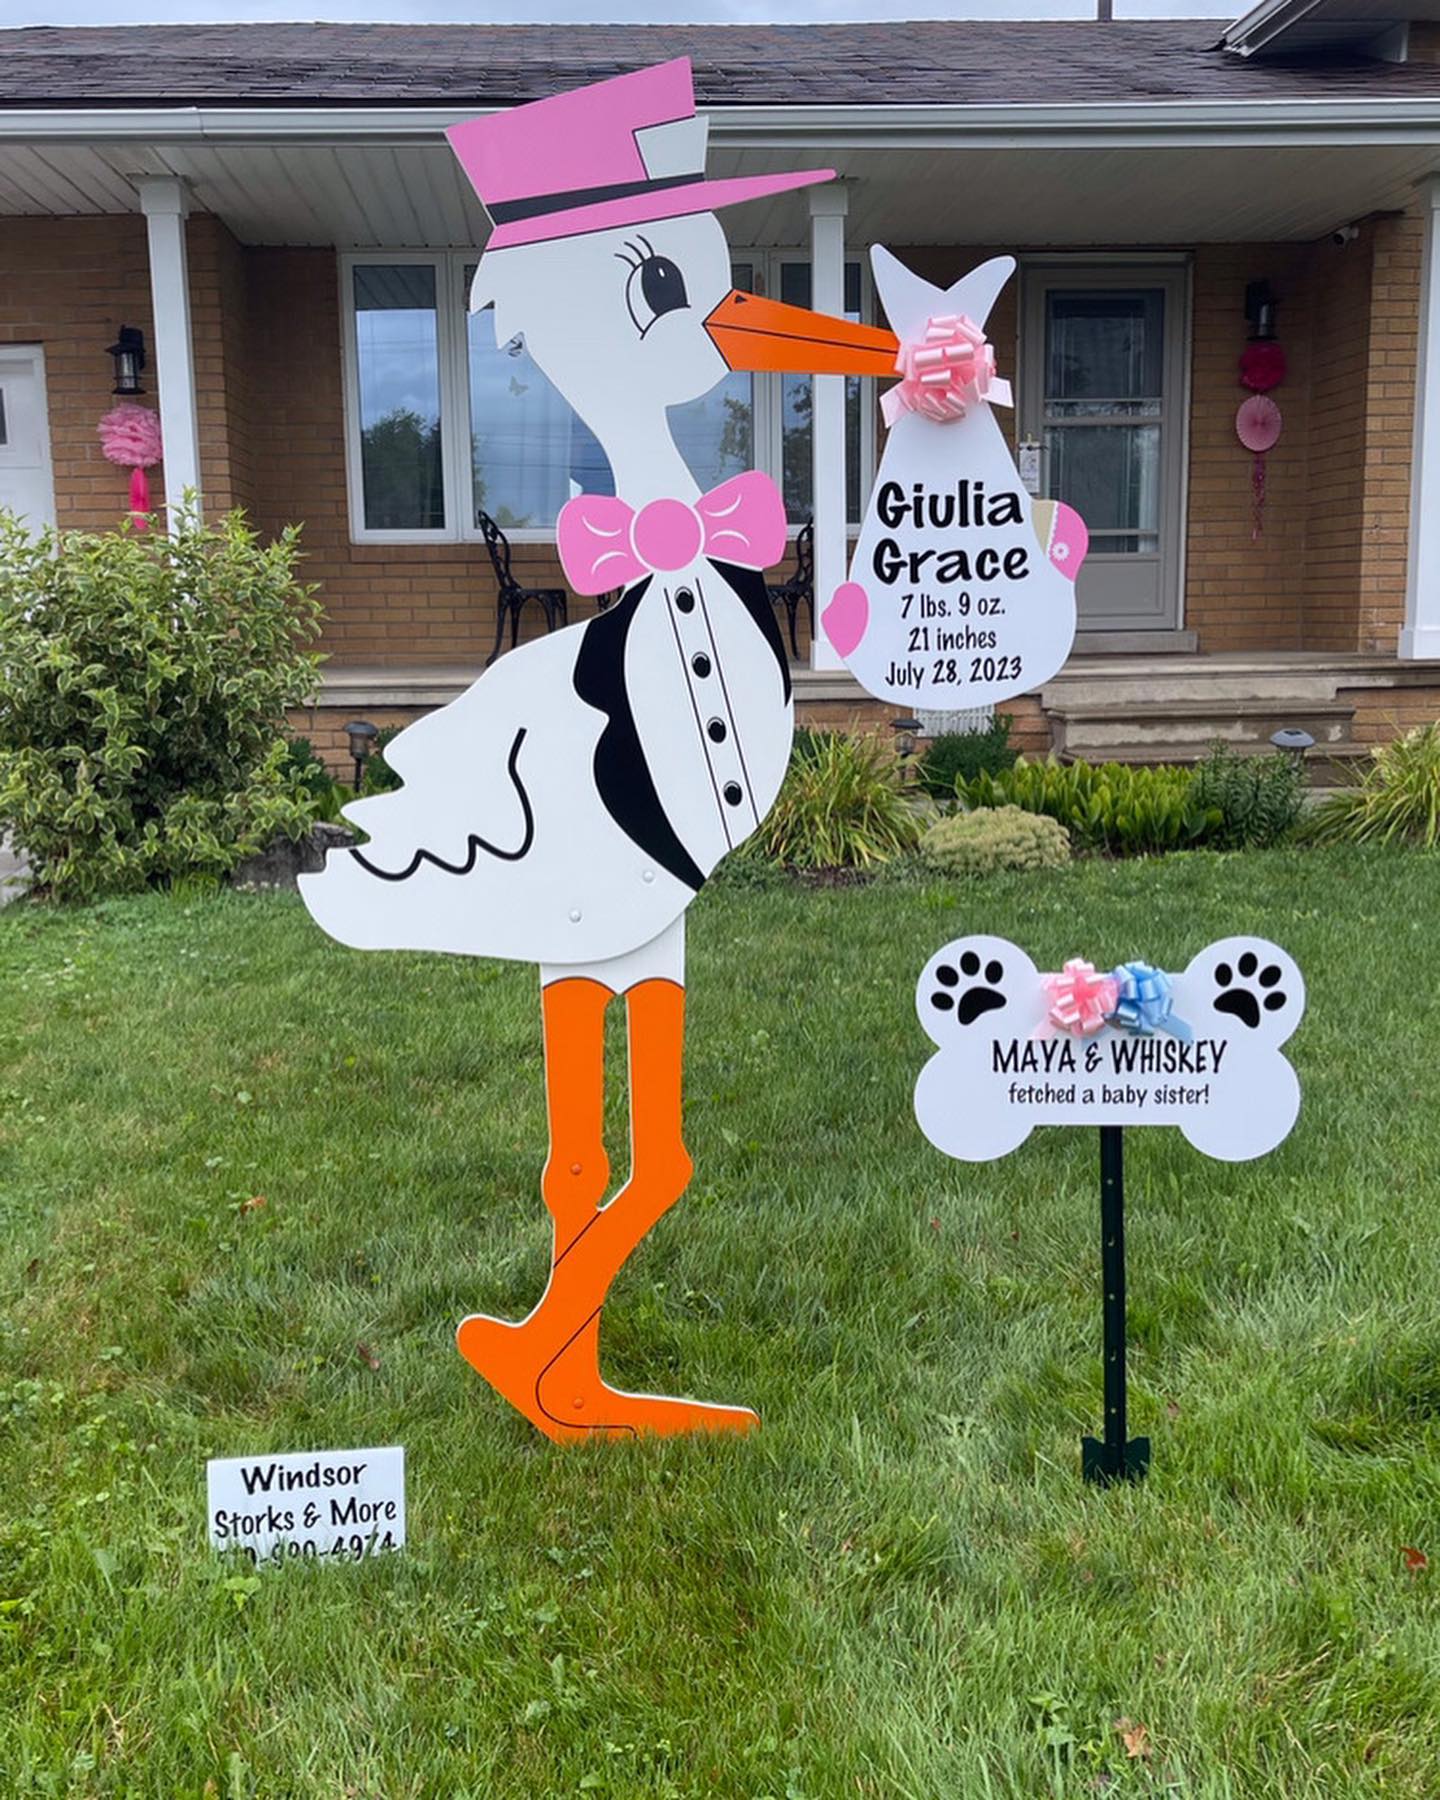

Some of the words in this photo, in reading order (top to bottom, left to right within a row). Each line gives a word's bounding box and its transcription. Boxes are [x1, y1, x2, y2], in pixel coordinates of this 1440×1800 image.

[876, 479, 1024, 529] Giulia
[872, 537, 1030, 586] Grace
[901, 593, 914, 619] 7
[920, 593, 952, 619] lbs.
[958, 591, 971, 617] 9
[977, 597, 1006, 616] oz.
[908, 626, 930, 653] 21
[937, 624, 997, 651] inches
[885, 660, 925, 690] July
[932, 658, 962, 686] 28,
[969, 655, 1022, 683] 2023
[992, 1038, 1077, 1074] MAYA
[1084, 1041, 1104, 1073] &
[1110, 1037, 1228, 1075] WHISKEY
[1008, 1082, 1076, 1104] fetched
[1082, 1088, 1095, 1104] a
[1102, 1084, 1148, 1108] baby
[1154, 1084, 1209, 1105] sister!
[240, 1462, 367, 1495] Windsor
[214, 1505, 295, 1539] Storks
[303, 1501, 321, 1529] &
[329, 1496, 397, 1526] More
